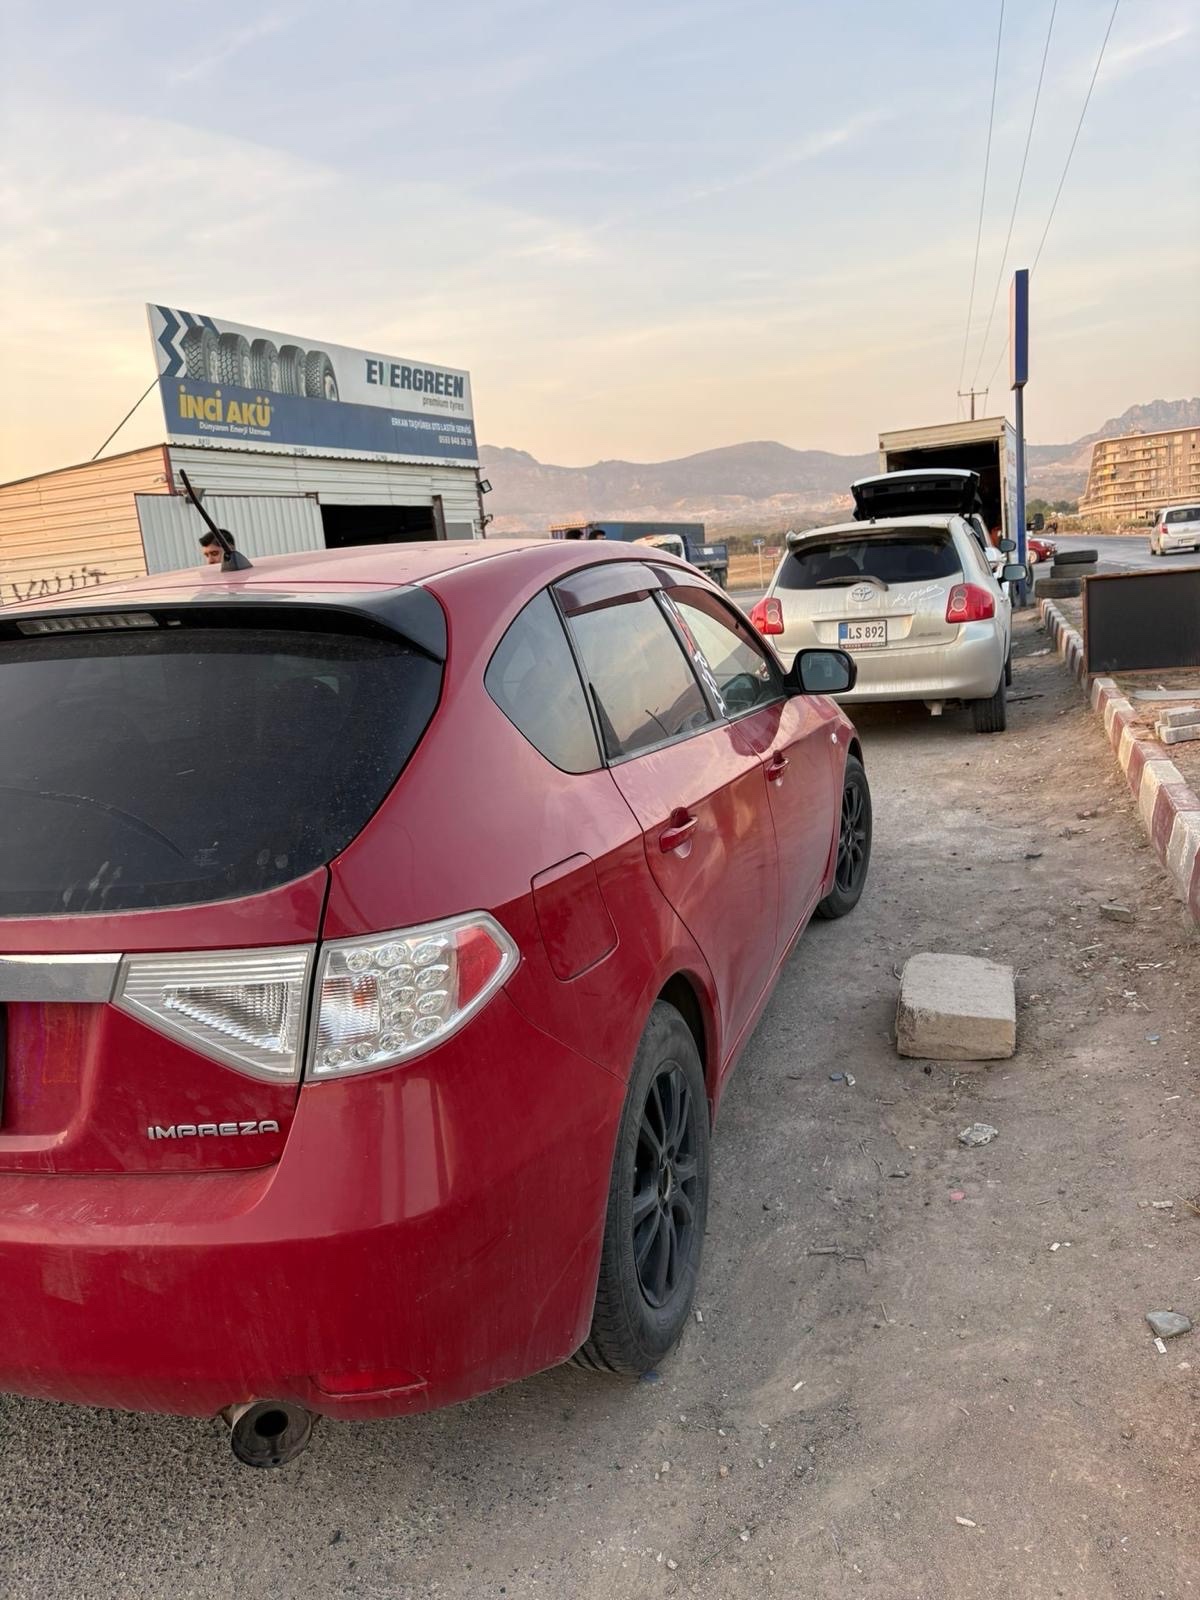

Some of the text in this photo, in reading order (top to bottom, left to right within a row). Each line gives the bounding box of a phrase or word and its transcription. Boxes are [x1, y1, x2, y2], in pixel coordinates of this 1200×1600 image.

[365, 358, 464, 398] EVERGREEN
[179, 384, 271, 428] İNCİ AKÜ
[423, 396, 464, 412] premium tyres
[230, 424, 248, 435] Enerji
[848, 626, 884, 640] LS 892
[147, 1119, 280, 1140] IMPREZA
